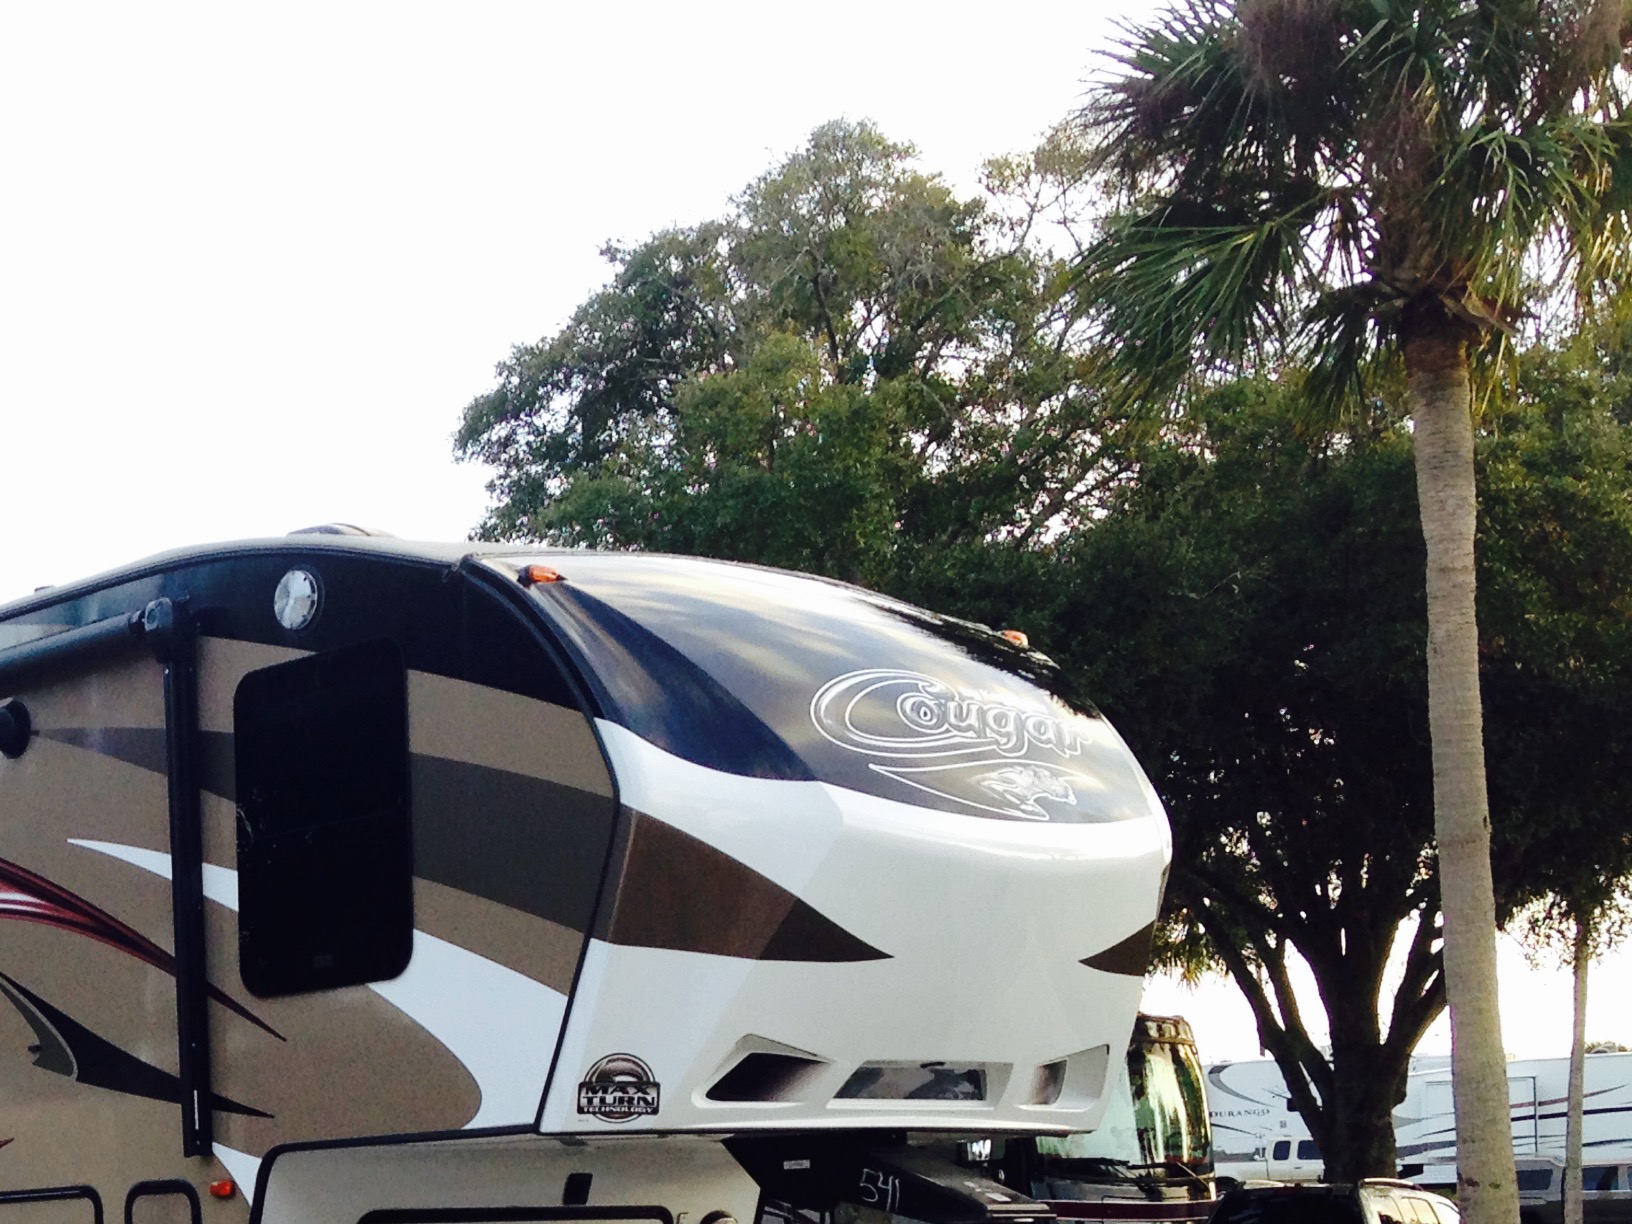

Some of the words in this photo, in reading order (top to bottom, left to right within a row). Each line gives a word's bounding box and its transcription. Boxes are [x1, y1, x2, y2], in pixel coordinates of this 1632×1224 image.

[810, 668, 1093, 759] Cougar
[585, 1085, 652, 1096] MAX
[582, 1095, 655, 1107] TURN
[1209, 1108, 1271, 1118] DURANGO
[858, 1167, 901, 1213] 541
